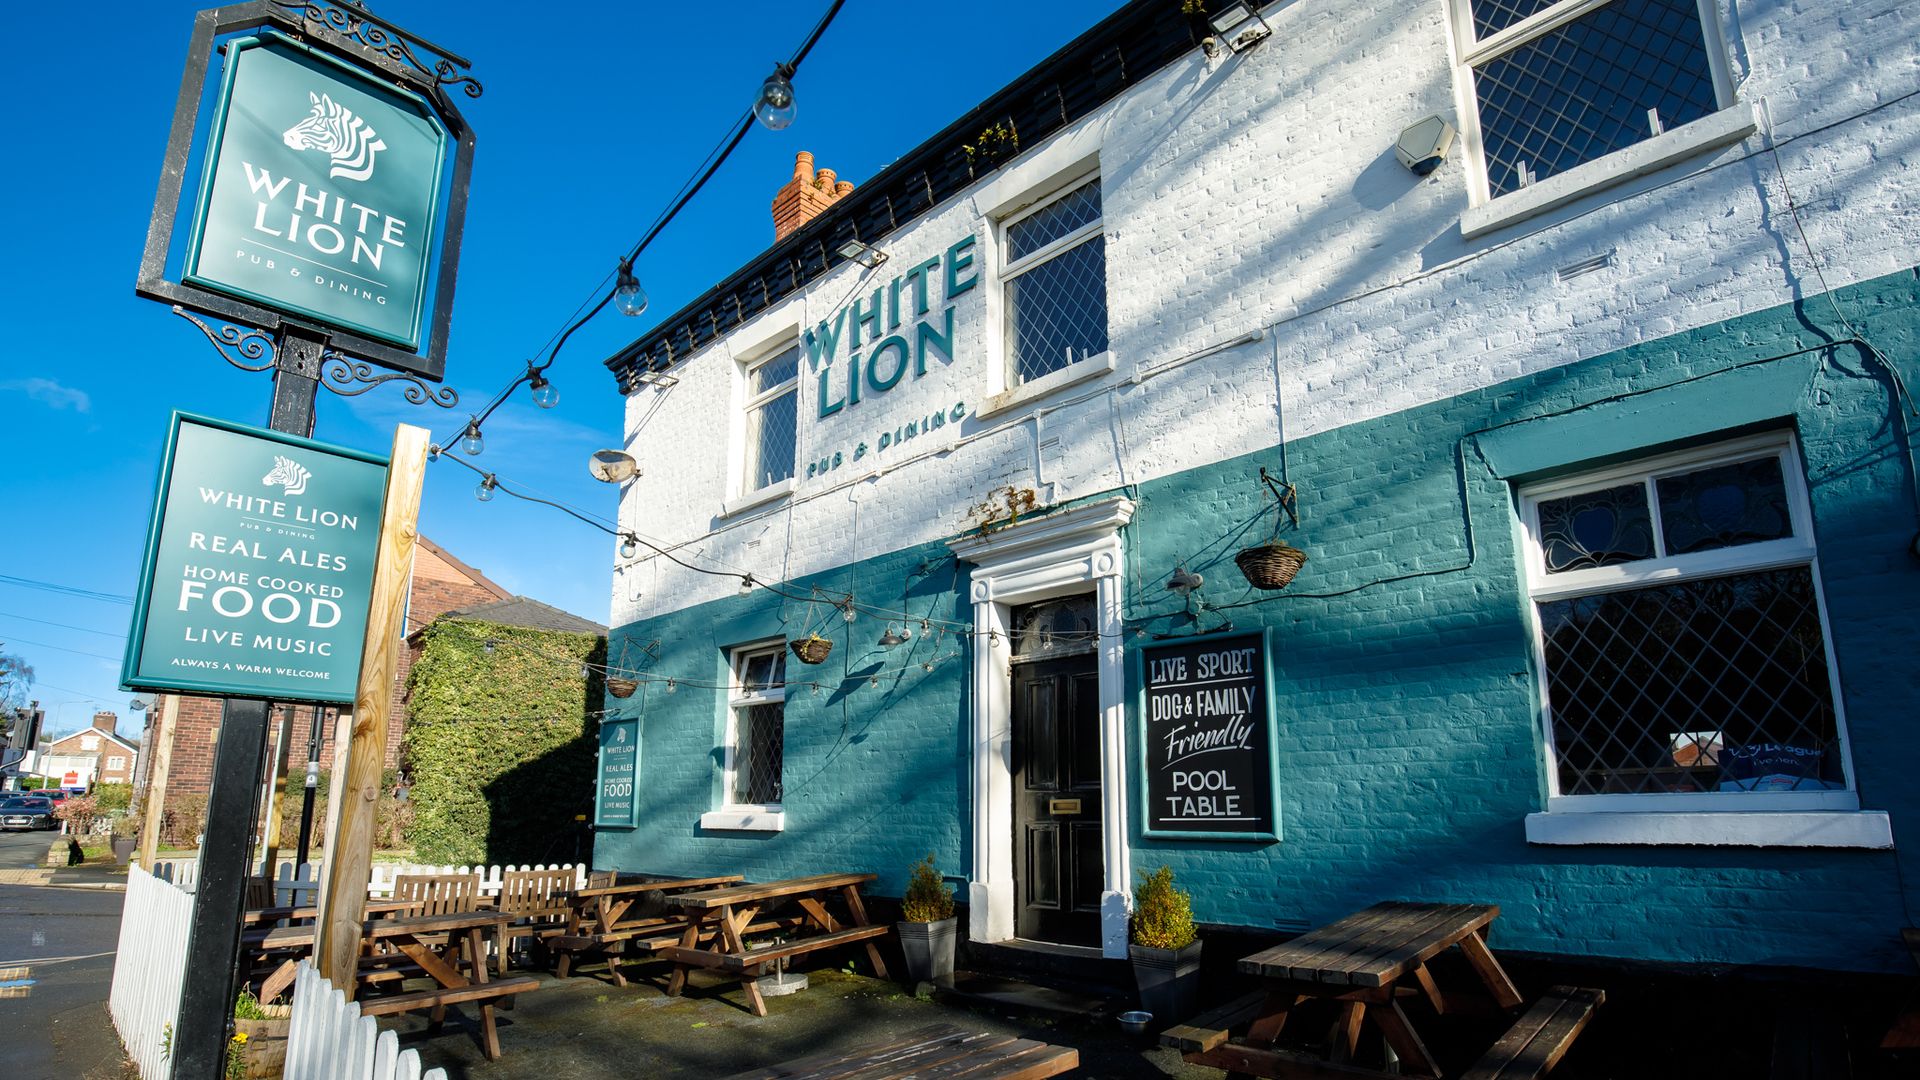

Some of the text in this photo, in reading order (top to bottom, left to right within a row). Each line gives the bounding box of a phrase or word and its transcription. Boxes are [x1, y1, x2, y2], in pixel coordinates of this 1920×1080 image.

[242, 162, 406, 248] WHITE
[254, 202, 384, 271] LION
[236, 250, 386, 305] PUB & DINING
[803, 234, 979, 371] WHITE
[820, 306, 956, 418] LION
[808, 400, 966, 477] PUB & DINING
[199, 487, 358, 531] WHITE LION
[240, 522, 260, 530] PUB
[279, 529, 315, 540] DINING
[190, 532, 347, 572] REAL ALES
[184, 565, 343, 598] HOME COOKED
[177, 579, 342, 628] FOOD
[185, 627, 332, 656] LIVE MUSIC
[171, 658, 218, 669] ALWAYS
[236, 664, 272, 674] WARM
[276, 669, 330, 679] WELCOME
[1150, 648, 1255, 683] LIVE SPORT
[1152, 686, 1255, 722] DOG & FAMILY
[607, 746, 621, 754] WHITE
[1163, 715, 1255, 762] Friendly
[604, 784, 632, 797] FOOD
[1173, 770, 1235, 792] POOL
[1166, 796, 1241, 816] TABLE
